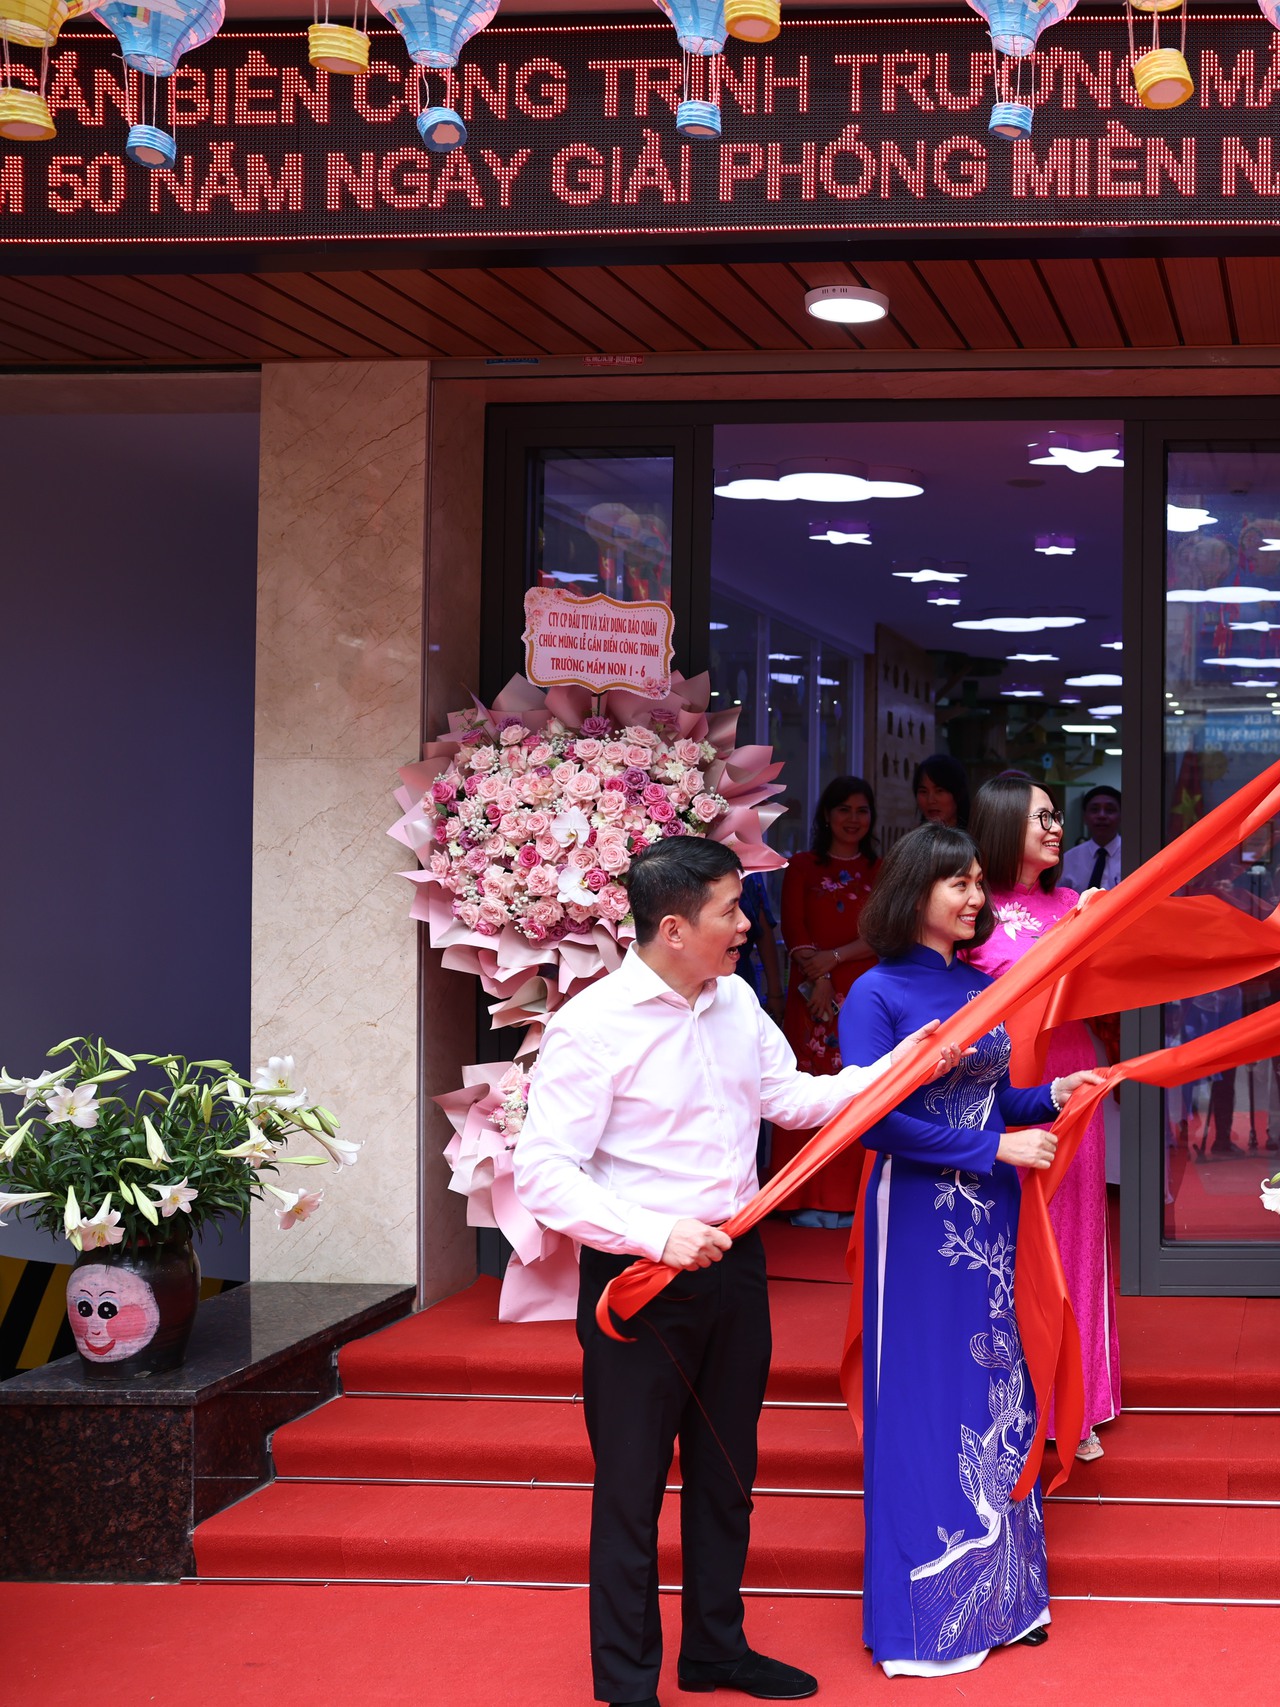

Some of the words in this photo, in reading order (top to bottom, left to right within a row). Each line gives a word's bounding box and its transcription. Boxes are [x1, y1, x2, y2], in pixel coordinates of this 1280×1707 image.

[48, 152, 126, 213] 50
[150, 141, 302, 212] NĂM
[551, 128, 690, 205] GIẢI
[719, 124, 988, 201] PHÓNG
[1013, 120, 1197, 198] MIỀN
[548, 611, 560, 627] CTY
[560, 612, 568, 627] CP
[539, 632, 557, 648] CHÚC
[558, 633, 578, 650] MỪNG
[619, 638, 639, 655] CÔNG
[551, 655, 585, 673] TRƯỜNG
[607, 662, 627, 676] NON
